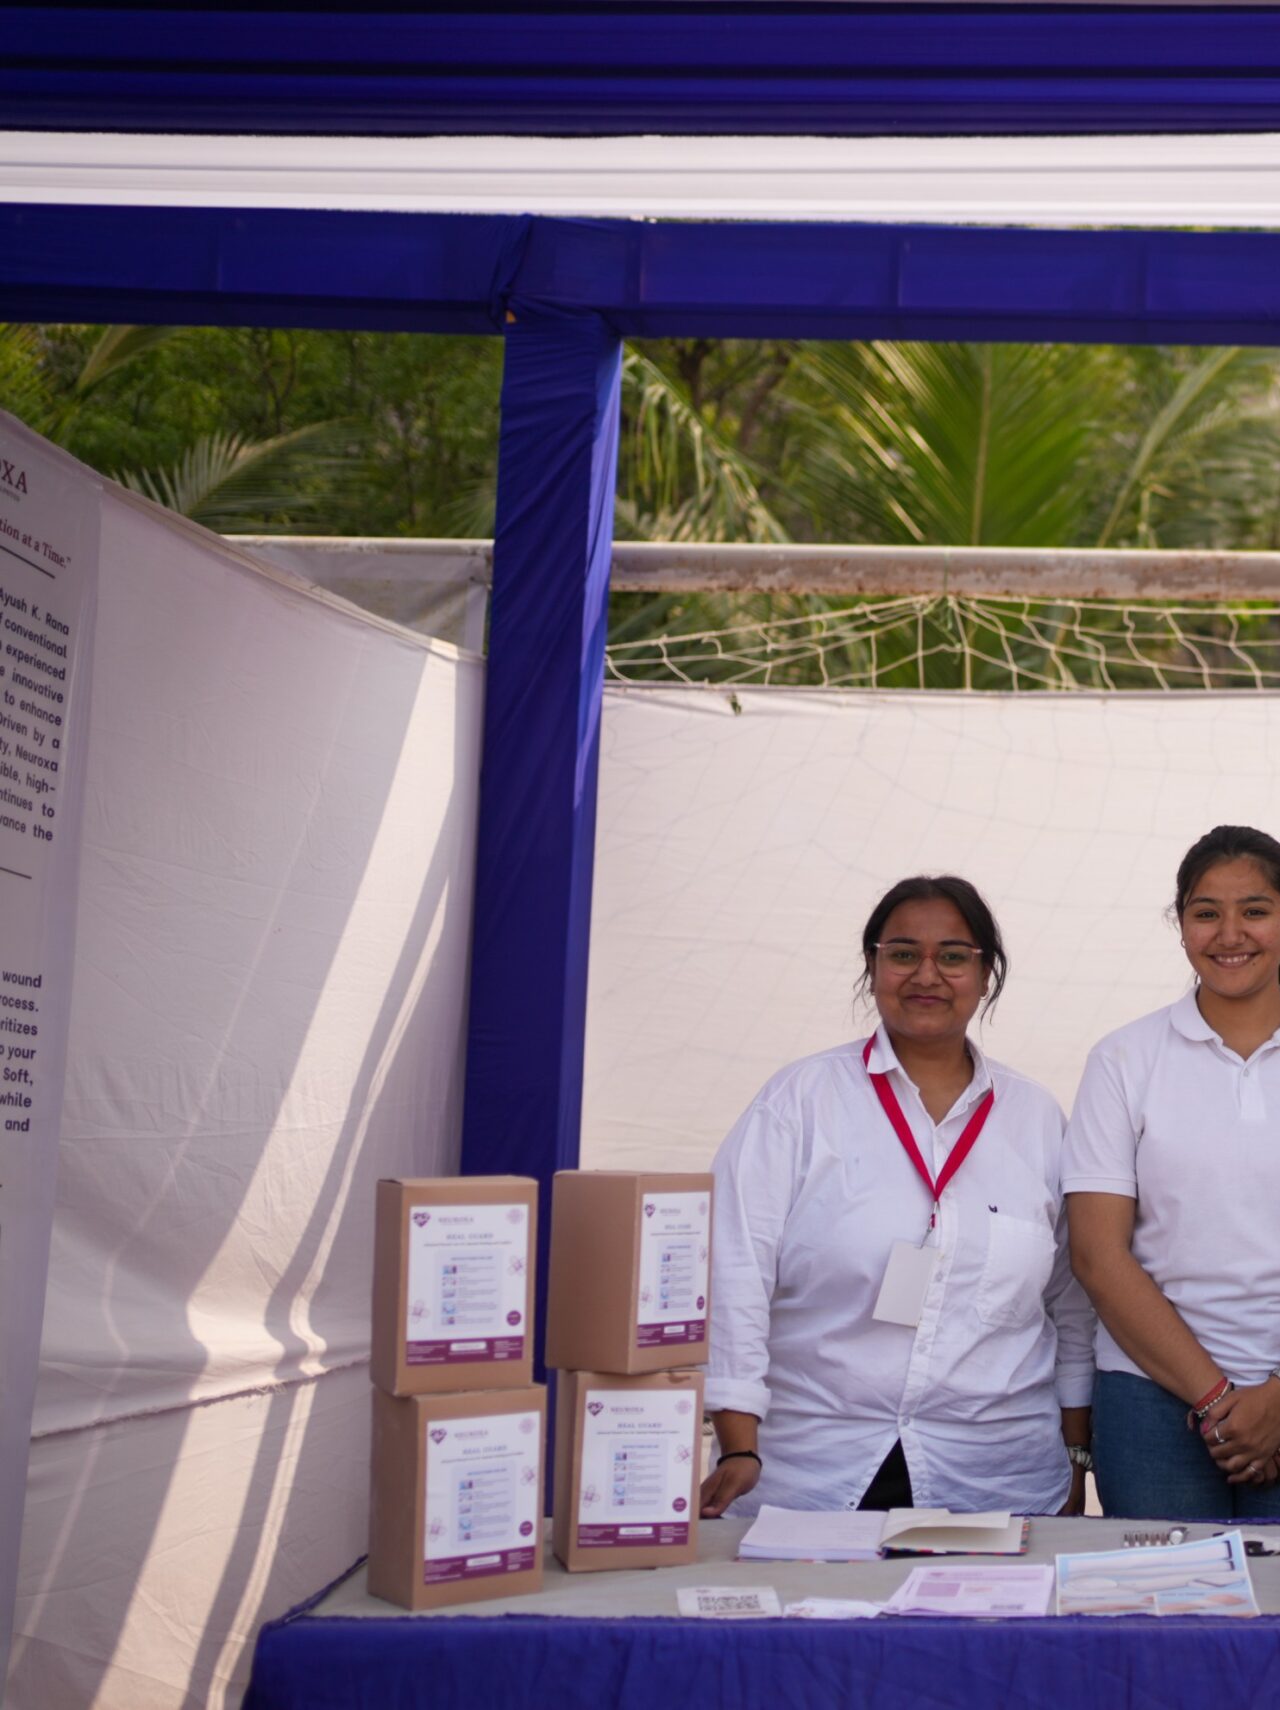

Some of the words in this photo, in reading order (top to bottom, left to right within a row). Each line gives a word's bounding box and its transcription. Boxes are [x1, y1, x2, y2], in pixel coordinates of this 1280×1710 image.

[0, 459, 28, 494] XA
[22, 533, 32, 548] at
[34, 541, 40, 552] a
[31, 604, 41, 621] K.
[45, 612, 70, 635] Rana
[4, 619, 67, 658] conventional
[6, 644, 66, 681] experienced
[12, 667, 64, 703] innovative
[4, 690, 15, 705] to
[20, 699, 62, 726] enhance
[33, 728, 45, 746] by
[52, 738, 60, 749] a
[15, 744, 58, 772] Neuroxa
[26, 772, 56, 794] high-
[42, 803, 55, 818] to
[33, 823, 53, 841] the
[3, 971, 42, 988] wound
[7, 1047, 36, 1060] your
[3, 1067, 34, 1086] Soft,
[5, 1118, 30, 1132] and
